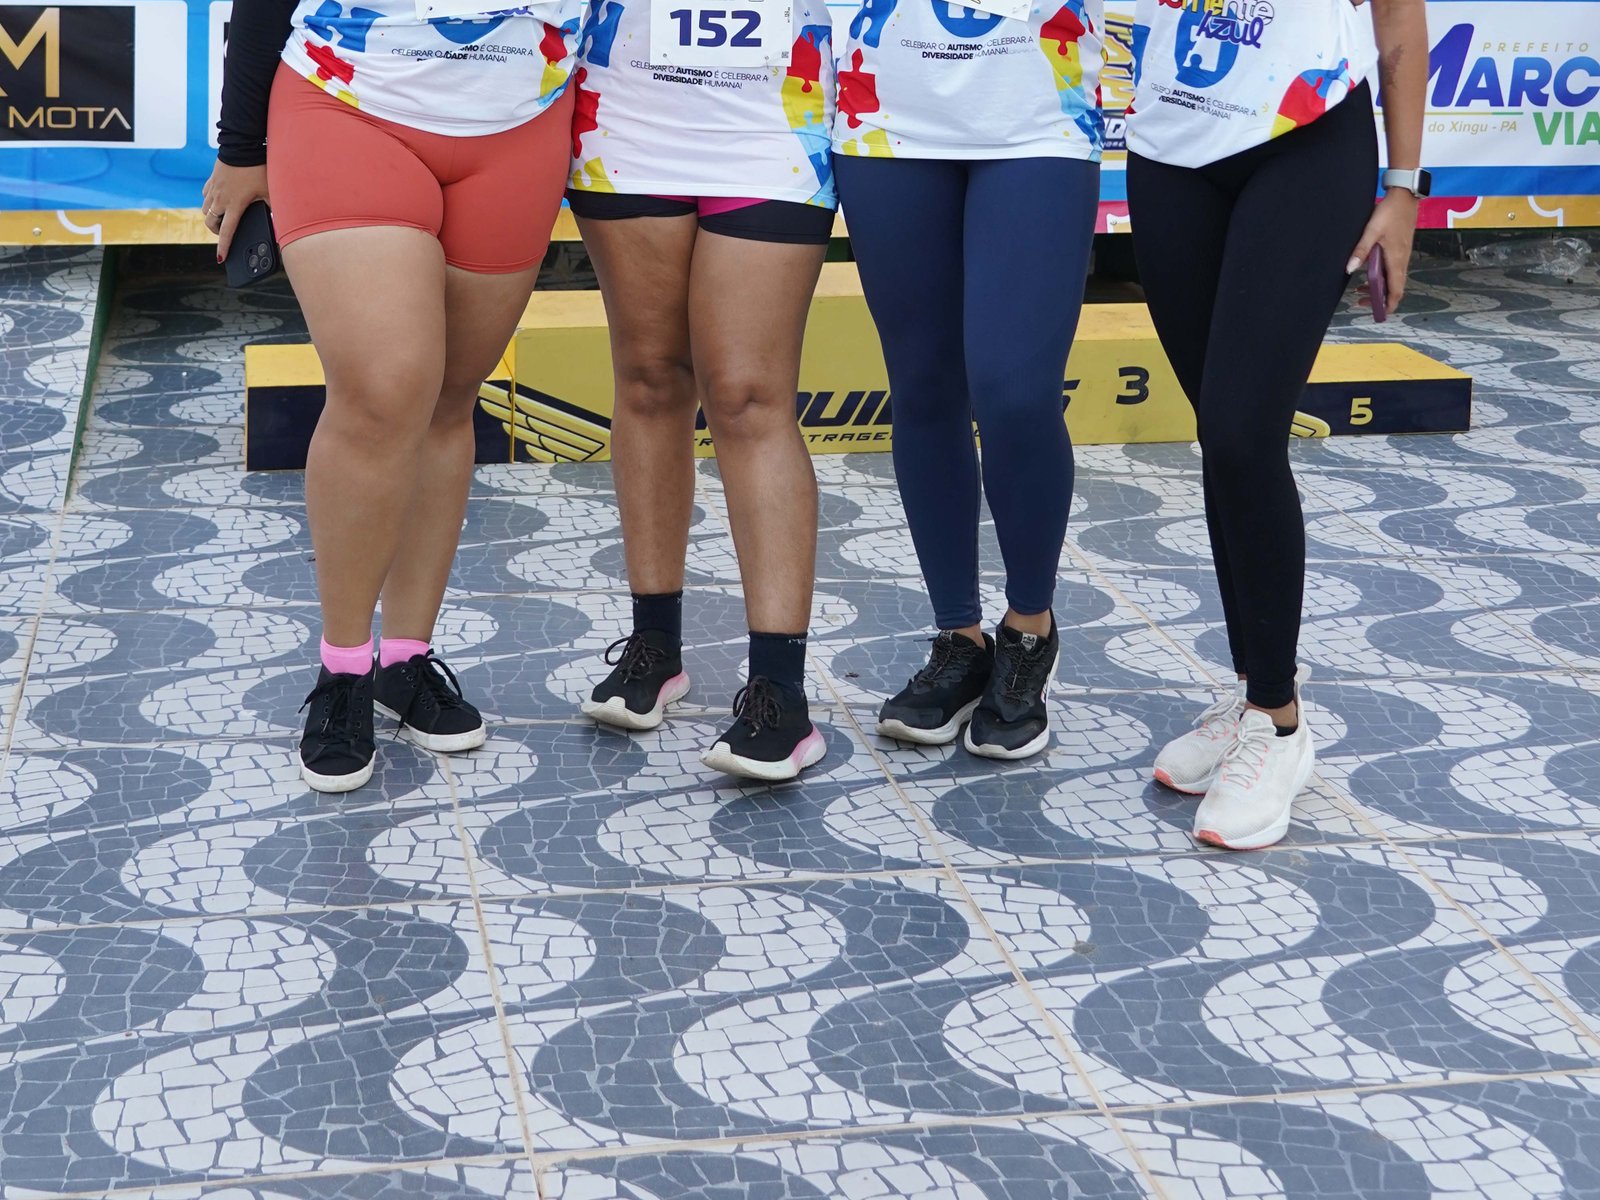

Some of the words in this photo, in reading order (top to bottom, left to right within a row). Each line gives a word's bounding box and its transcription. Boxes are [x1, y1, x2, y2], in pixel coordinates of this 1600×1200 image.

[670, 9, 762, 47] 152
[1196, 10, 1264, 49] Azul
[486, 45, 527, 55] CELEBRAR
[901, 39, 937, 50] CELEBRAR
[1483, 42, 1589, 53] PREFEITO
[469, 53, 507, 63] HUMANA!
[922, 52, 974, 60] DIVERSIDADE
[630, 60, 667, 72] CELEBRAR
[675, 67, 713, 78] AUTISMO
[721, 71, 761, 81] CELEBRAR
[762, 74, 769, 82] A
[653, 73, 703, 86] DIVERSIDADE
[704, 80, 743, 89] HUMANA!
[1172, 89, 1205, 103] AUTISMO
[1212, 100, 1249, 115] CELEBRAR
[9, 106, 131, 129] MOTA
[1197, 105, 1231, 120] HUMANA!
[1428, 121, 1444, 133] do
[1449, 121, 1488, 135] Xingu
[1501, 121, 1517, 132] PA
[1116, 366, 1150, 405] 3
[1350, 397, 1373, 426] 5
